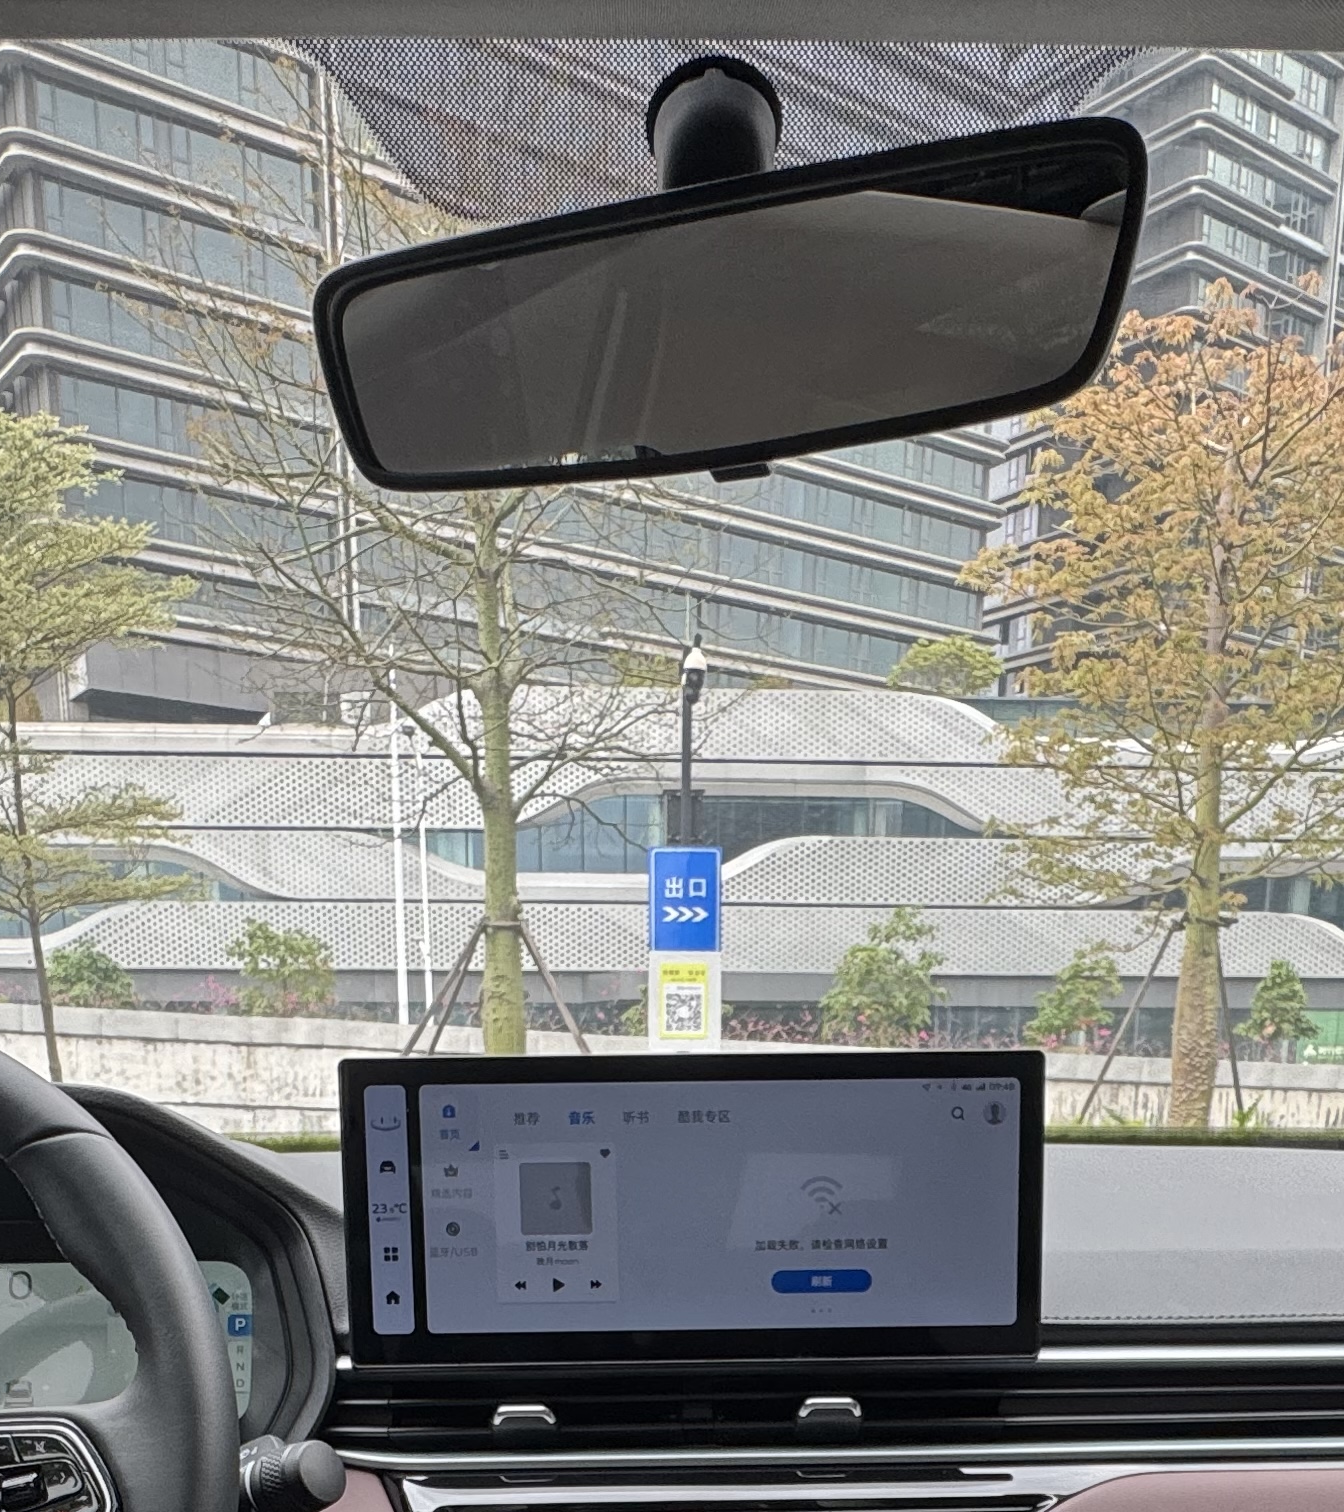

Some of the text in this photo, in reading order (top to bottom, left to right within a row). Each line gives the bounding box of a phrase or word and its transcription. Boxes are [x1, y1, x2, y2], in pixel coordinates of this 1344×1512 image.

[664, 876, 707, 899] 出口
[513, 1112, 541, 1126] 推荐
[568, 1111, 596, 1125] 音乐
[623, 1110, 650, 1124] 听书
[677, 1109, 731, 1123] 酷我专区
[234, 1317, 247, 1332] P
[236, 1362, 245, 1371] N
[236, 1379, 245, 1388] D
